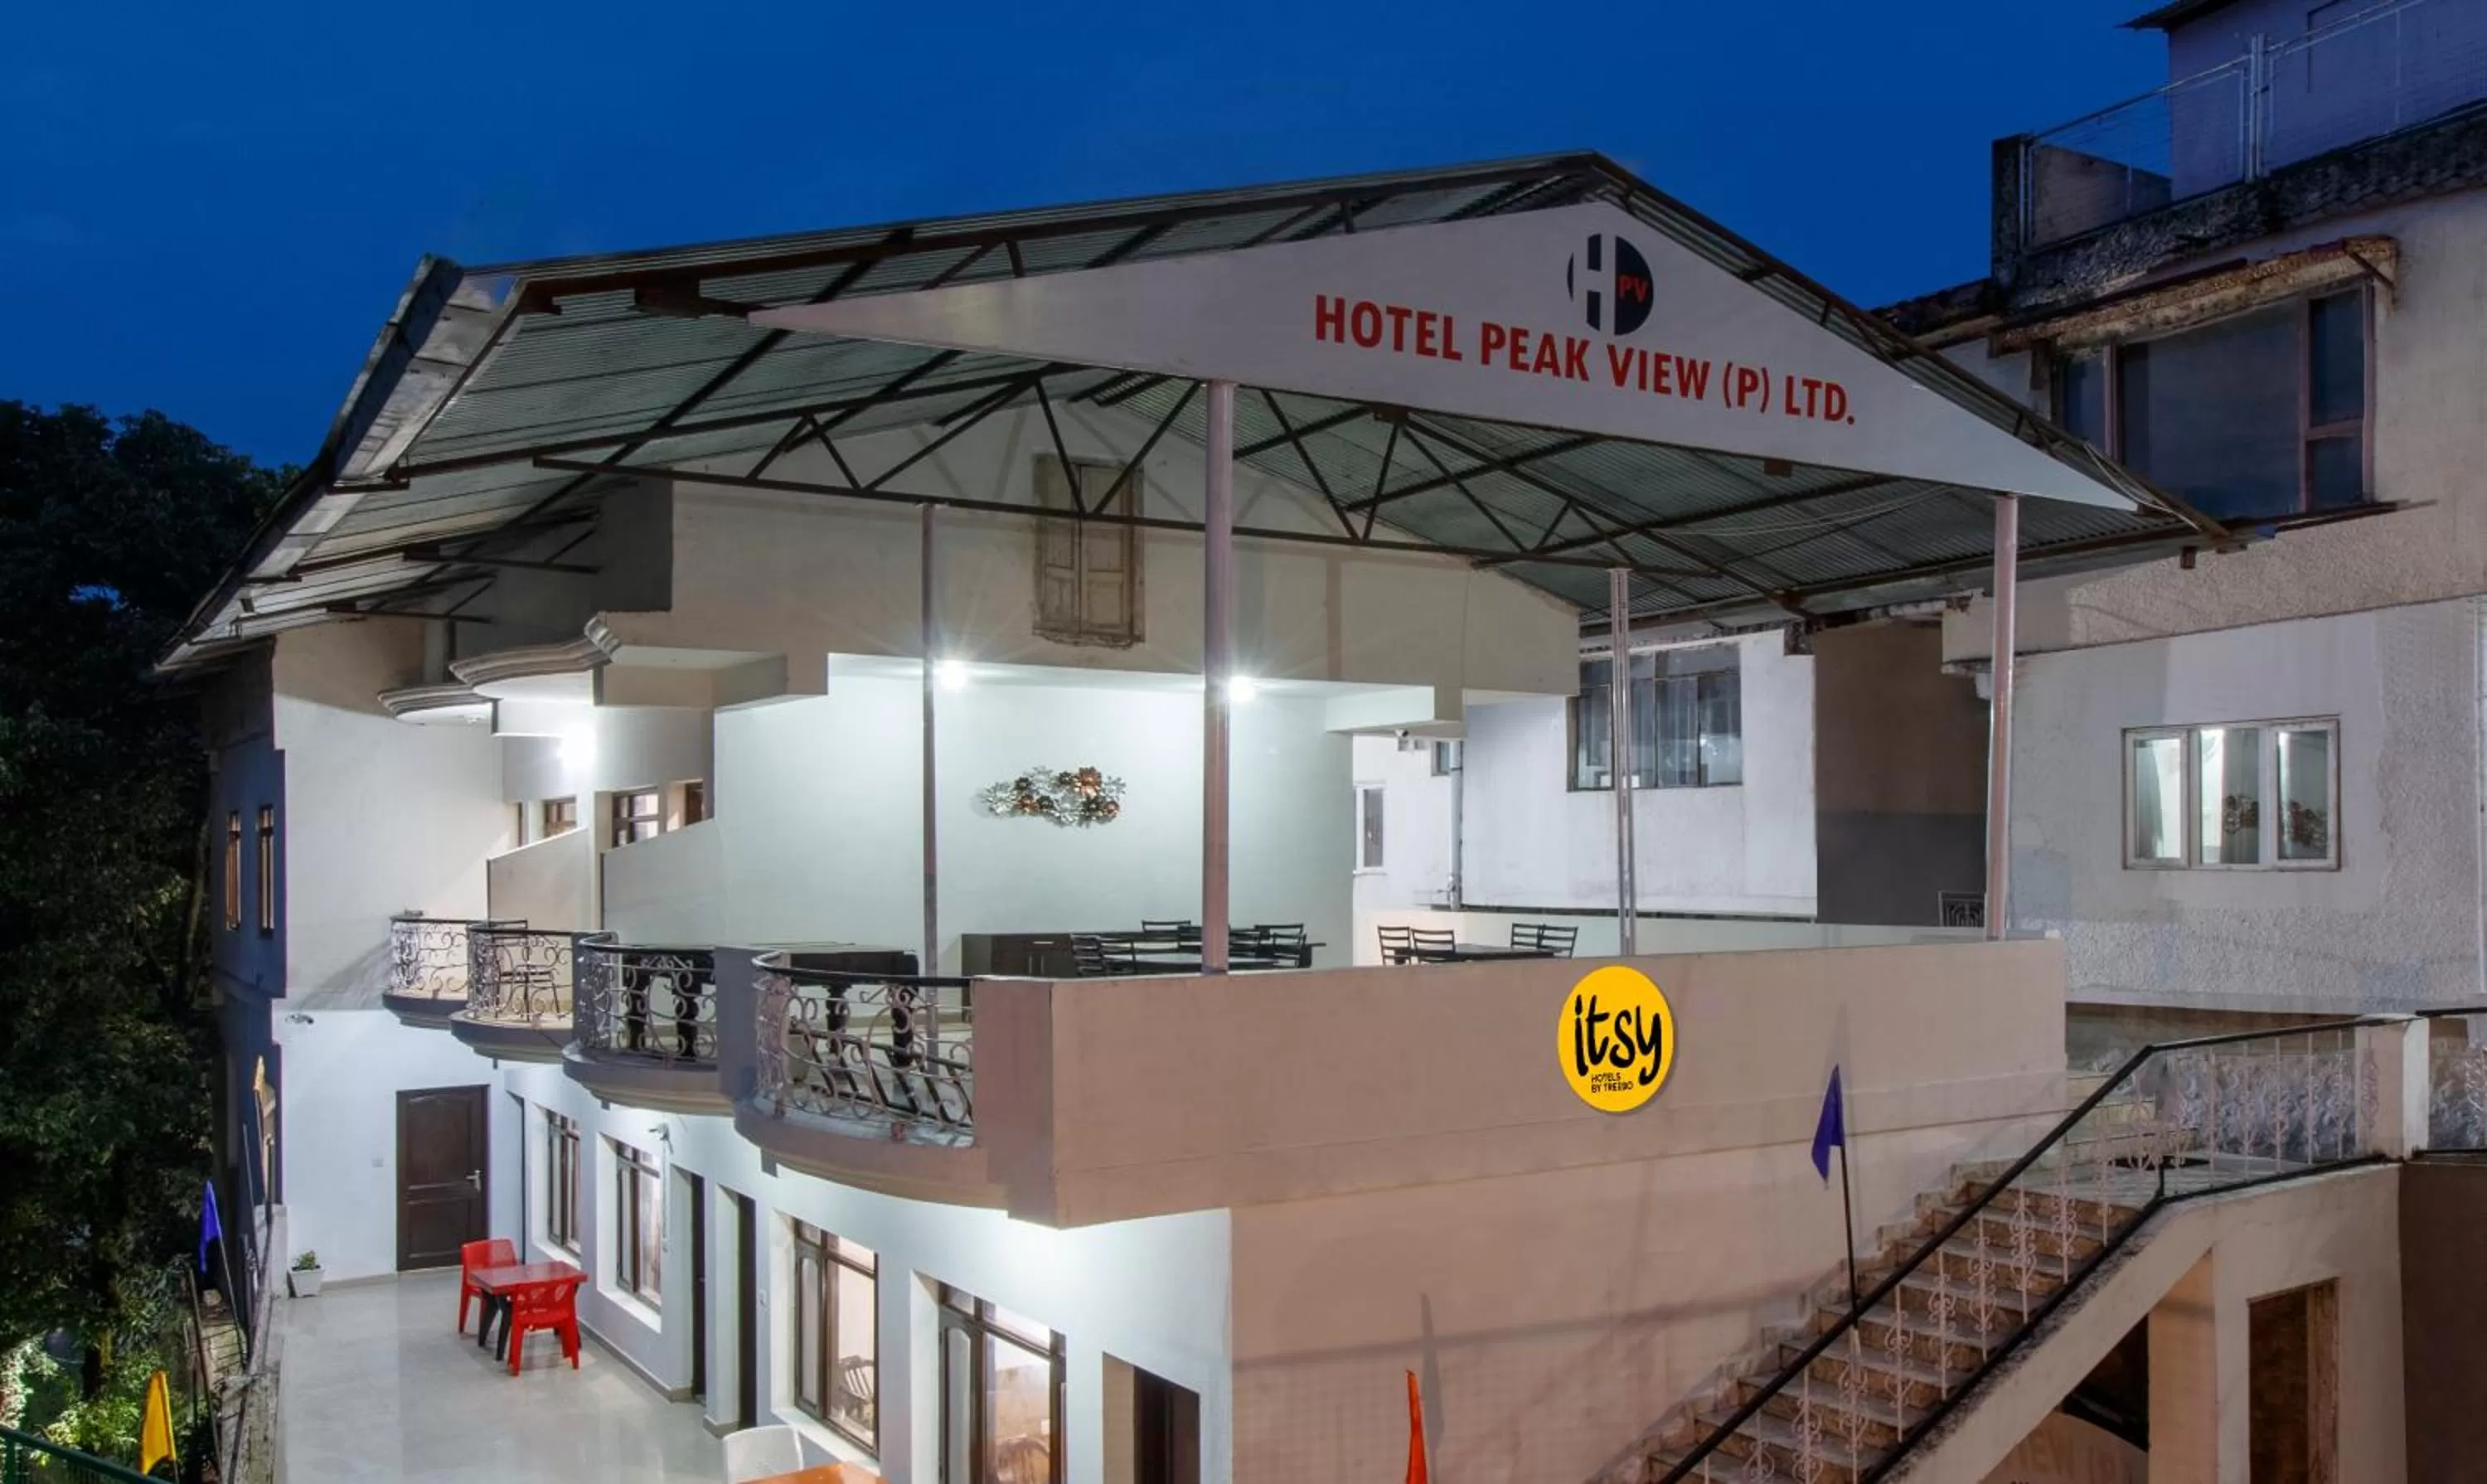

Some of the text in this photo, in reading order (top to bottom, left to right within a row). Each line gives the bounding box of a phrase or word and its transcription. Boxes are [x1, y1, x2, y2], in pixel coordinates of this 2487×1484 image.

[1617, 274, 1649, 303] PV
[1315, 293, 1855, 425] HOTEL PEAK VIEW (P) LTD.
[1573, 994, 1663, 1087] itsy
[1591, 1072, 1622, 1084] HOTELS
[1591, 1083, 1602, 1094] BY
